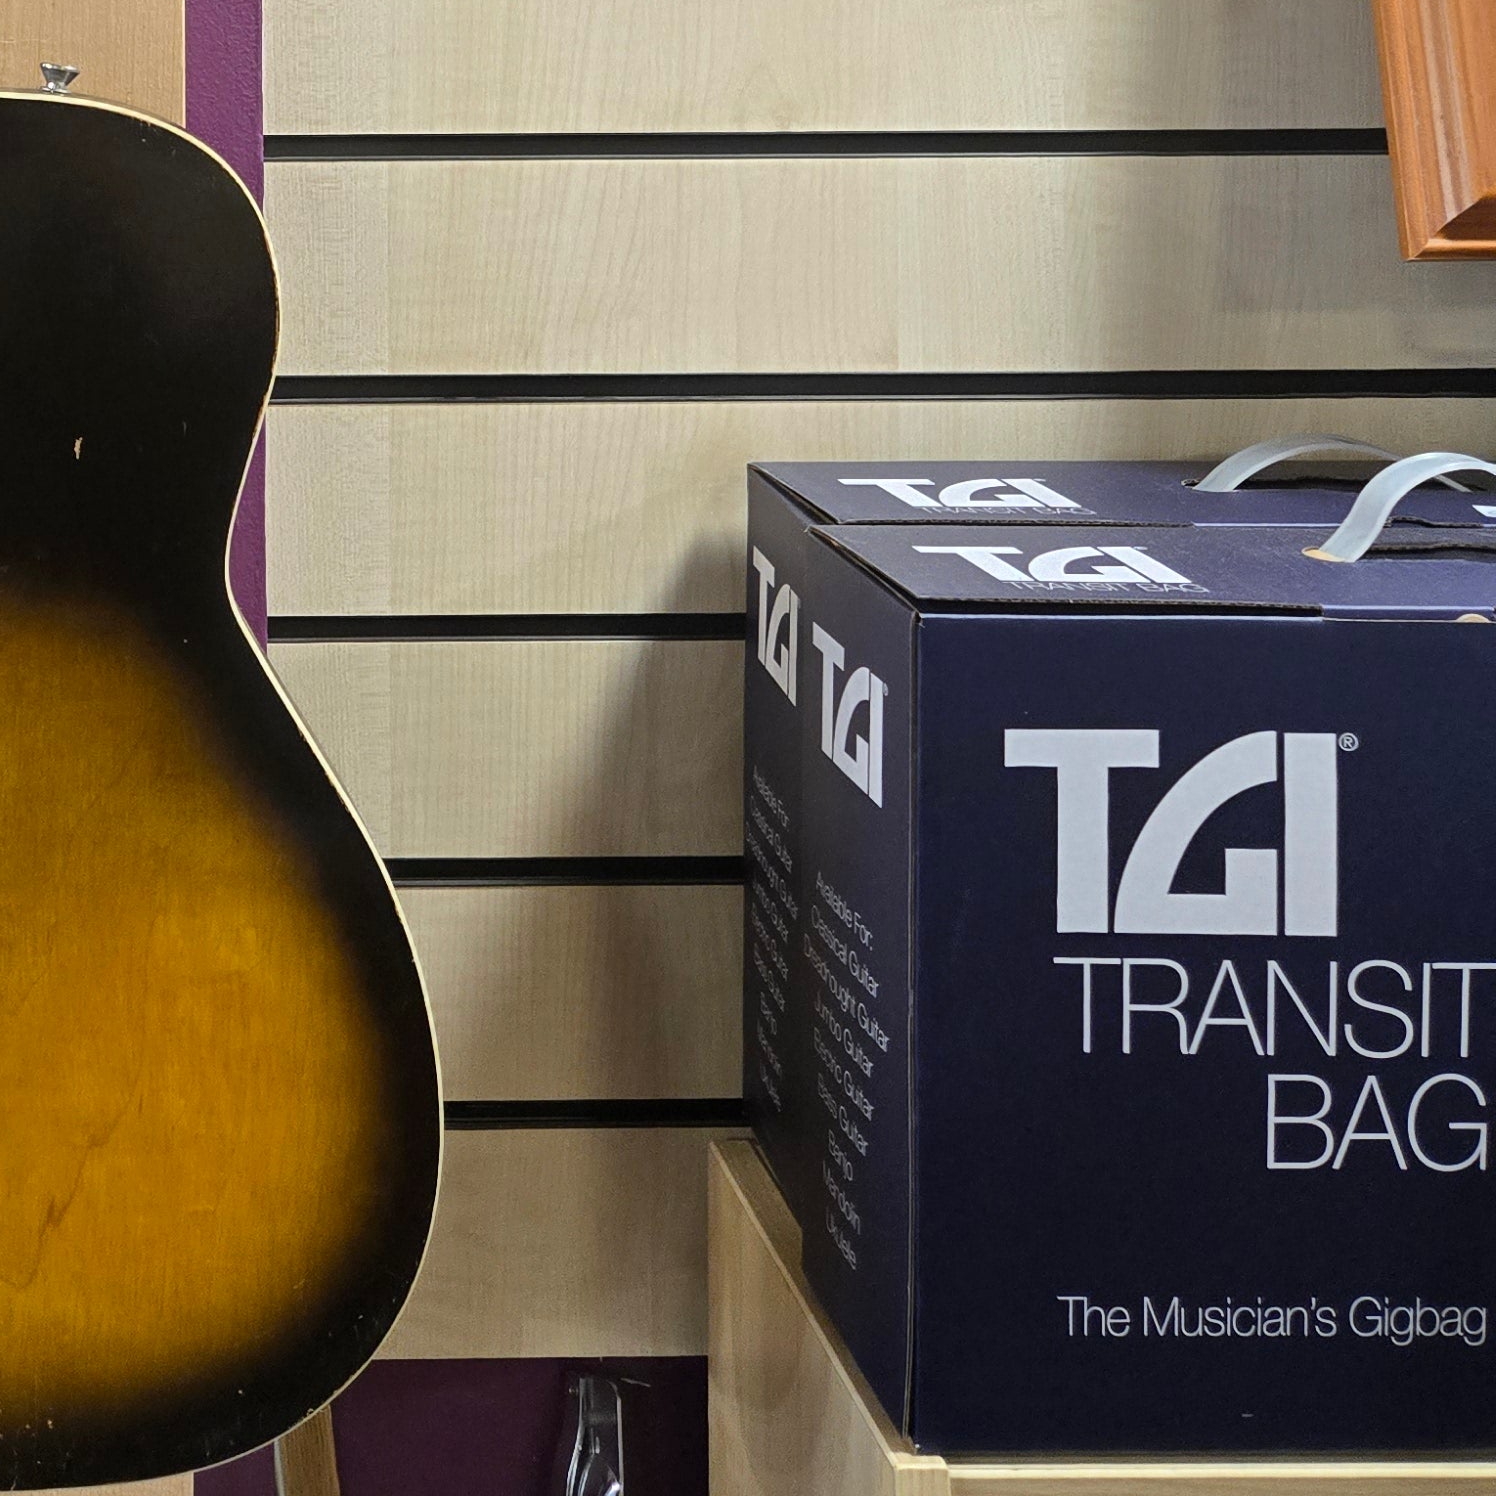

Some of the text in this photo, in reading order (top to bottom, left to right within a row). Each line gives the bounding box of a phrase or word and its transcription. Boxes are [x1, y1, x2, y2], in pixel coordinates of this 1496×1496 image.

[918, 506, 1097, 515] TRANSIT BAG
[1002, 580, 1210, 593] TRANSIT BAG
[811, 905, 879, 999] Classical Guitar
[857, 1003, 890, 1053] Guitar
[1053, 956, 1496, 1059] TRANSIT
[843, 1028, 874, 1078] Guitar
[844, 1070, 875, 1121] Guitar
[839, 1105, 869, 1156] Guitar
[1266, 1073, 1488, 1172] BAG
[829, 1129, 853, 1182] Banjo
[1056, 1295, 1487, 1347] The Musician's Gigbag
